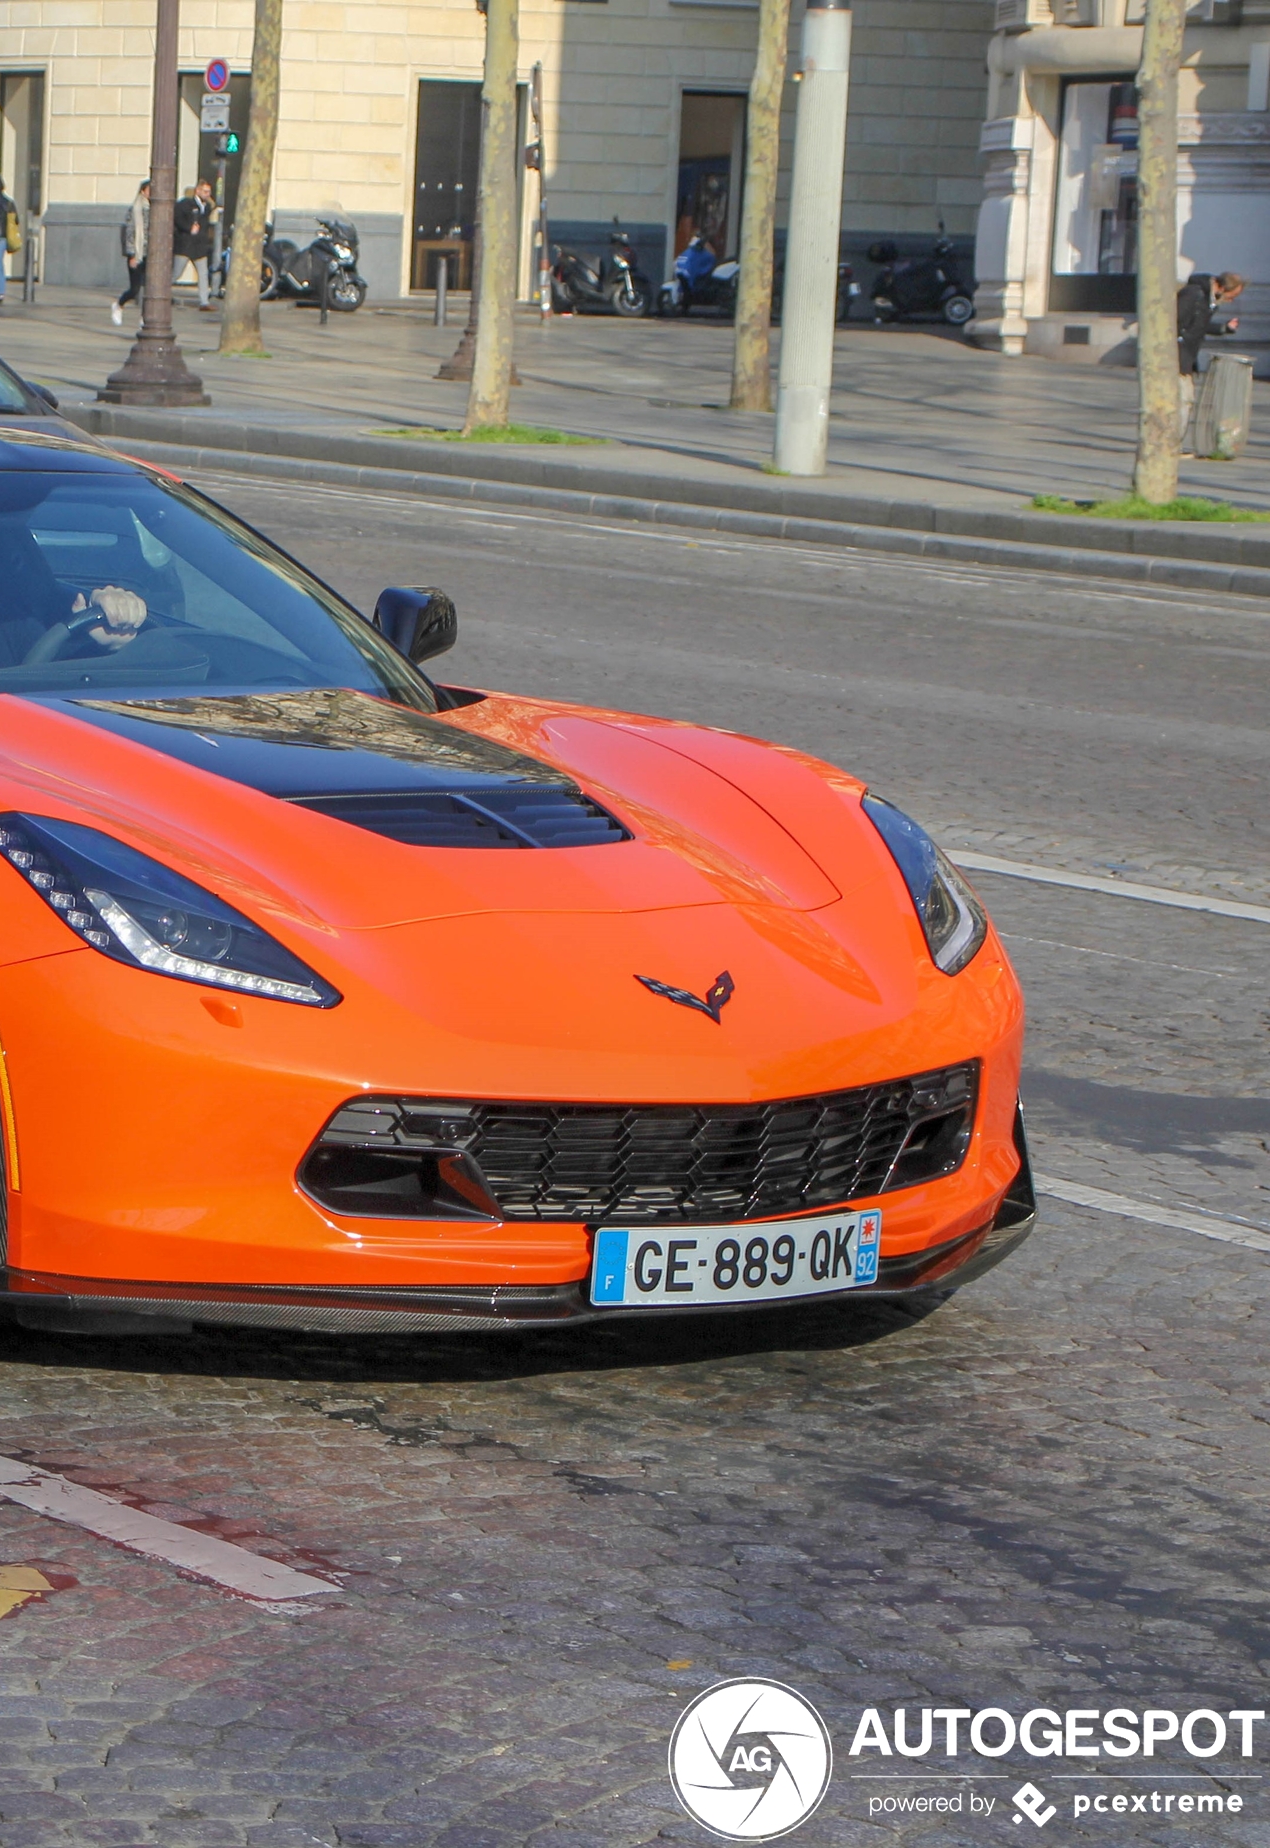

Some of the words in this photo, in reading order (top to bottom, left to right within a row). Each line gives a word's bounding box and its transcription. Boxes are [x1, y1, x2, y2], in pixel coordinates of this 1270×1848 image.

[633, 1224, 856, 1294] GE-889-QK
[856, 1250, 876, 1276] 92
[603, 1274, 615, 1290] F
